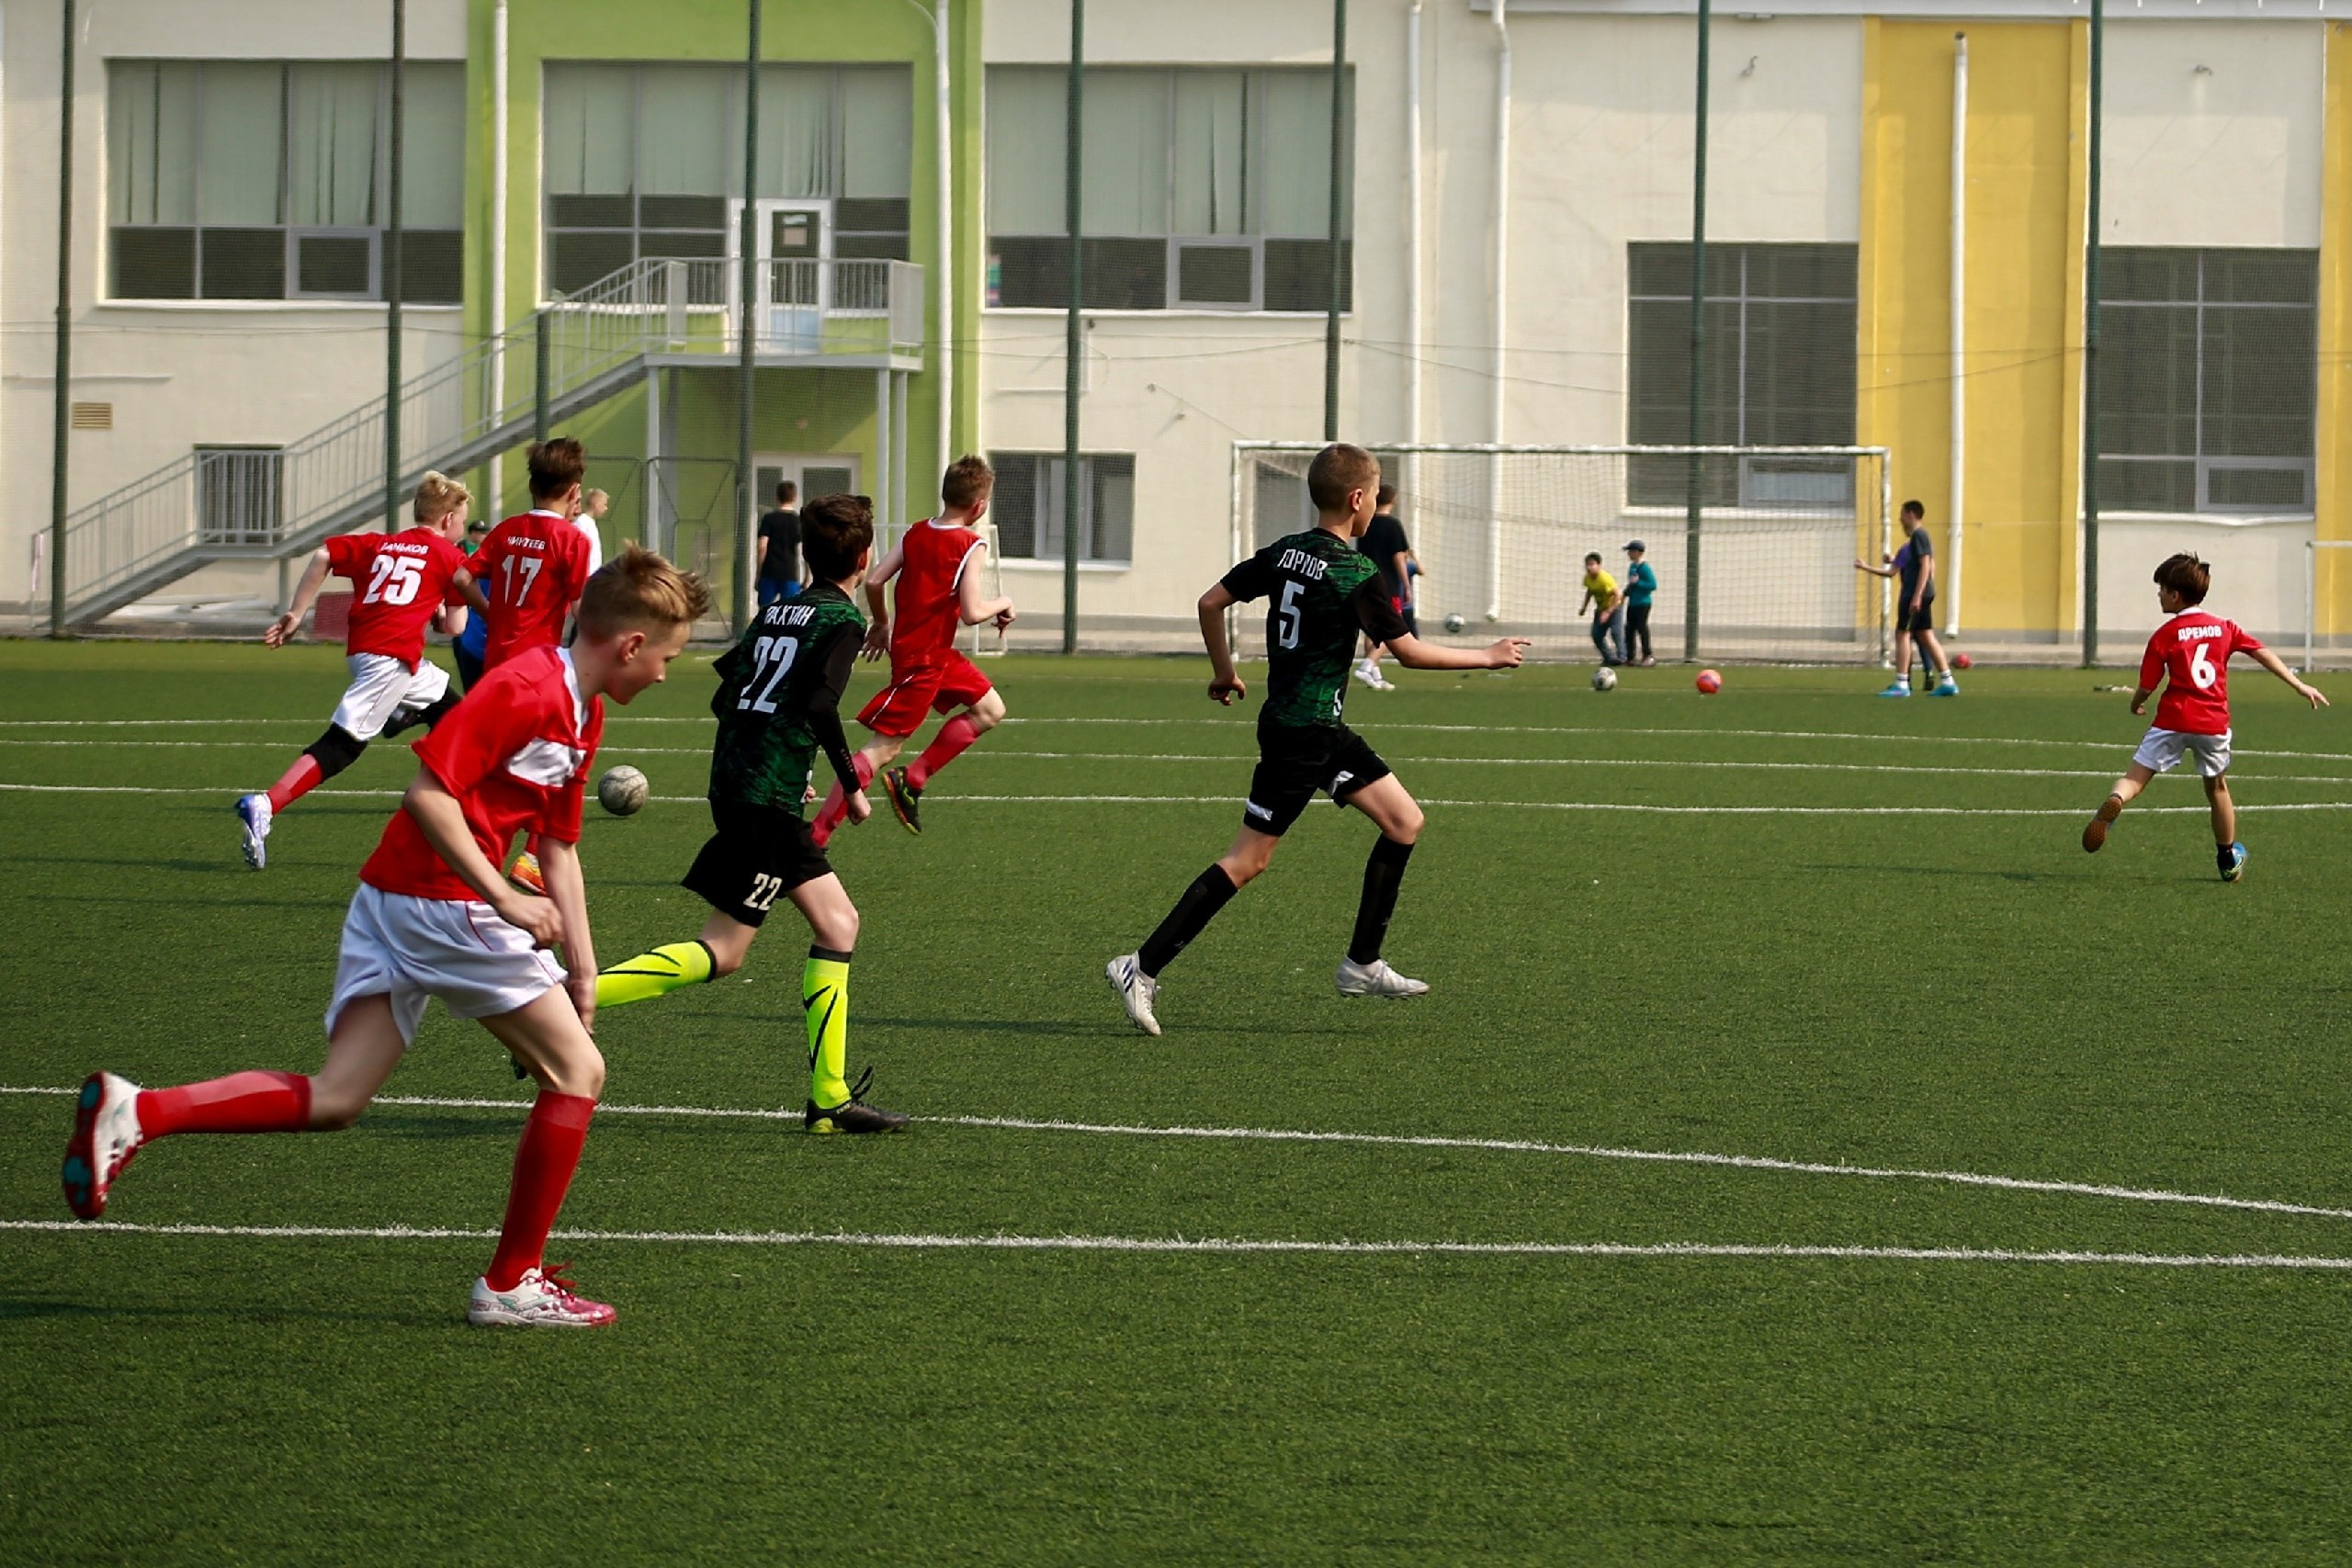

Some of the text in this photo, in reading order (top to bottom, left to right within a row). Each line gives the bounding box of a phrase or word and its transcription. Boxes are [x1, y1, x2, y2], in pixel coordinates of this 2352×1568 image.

[363, 555, 427, 605] 25
[502, 555, 543, 606] 17
[1279, 580, 1306, 649] 5
[737, 636, 798, 714] 22
[2191, 643, 2216, 689] 6
[743, 873, 783, 911] 22
